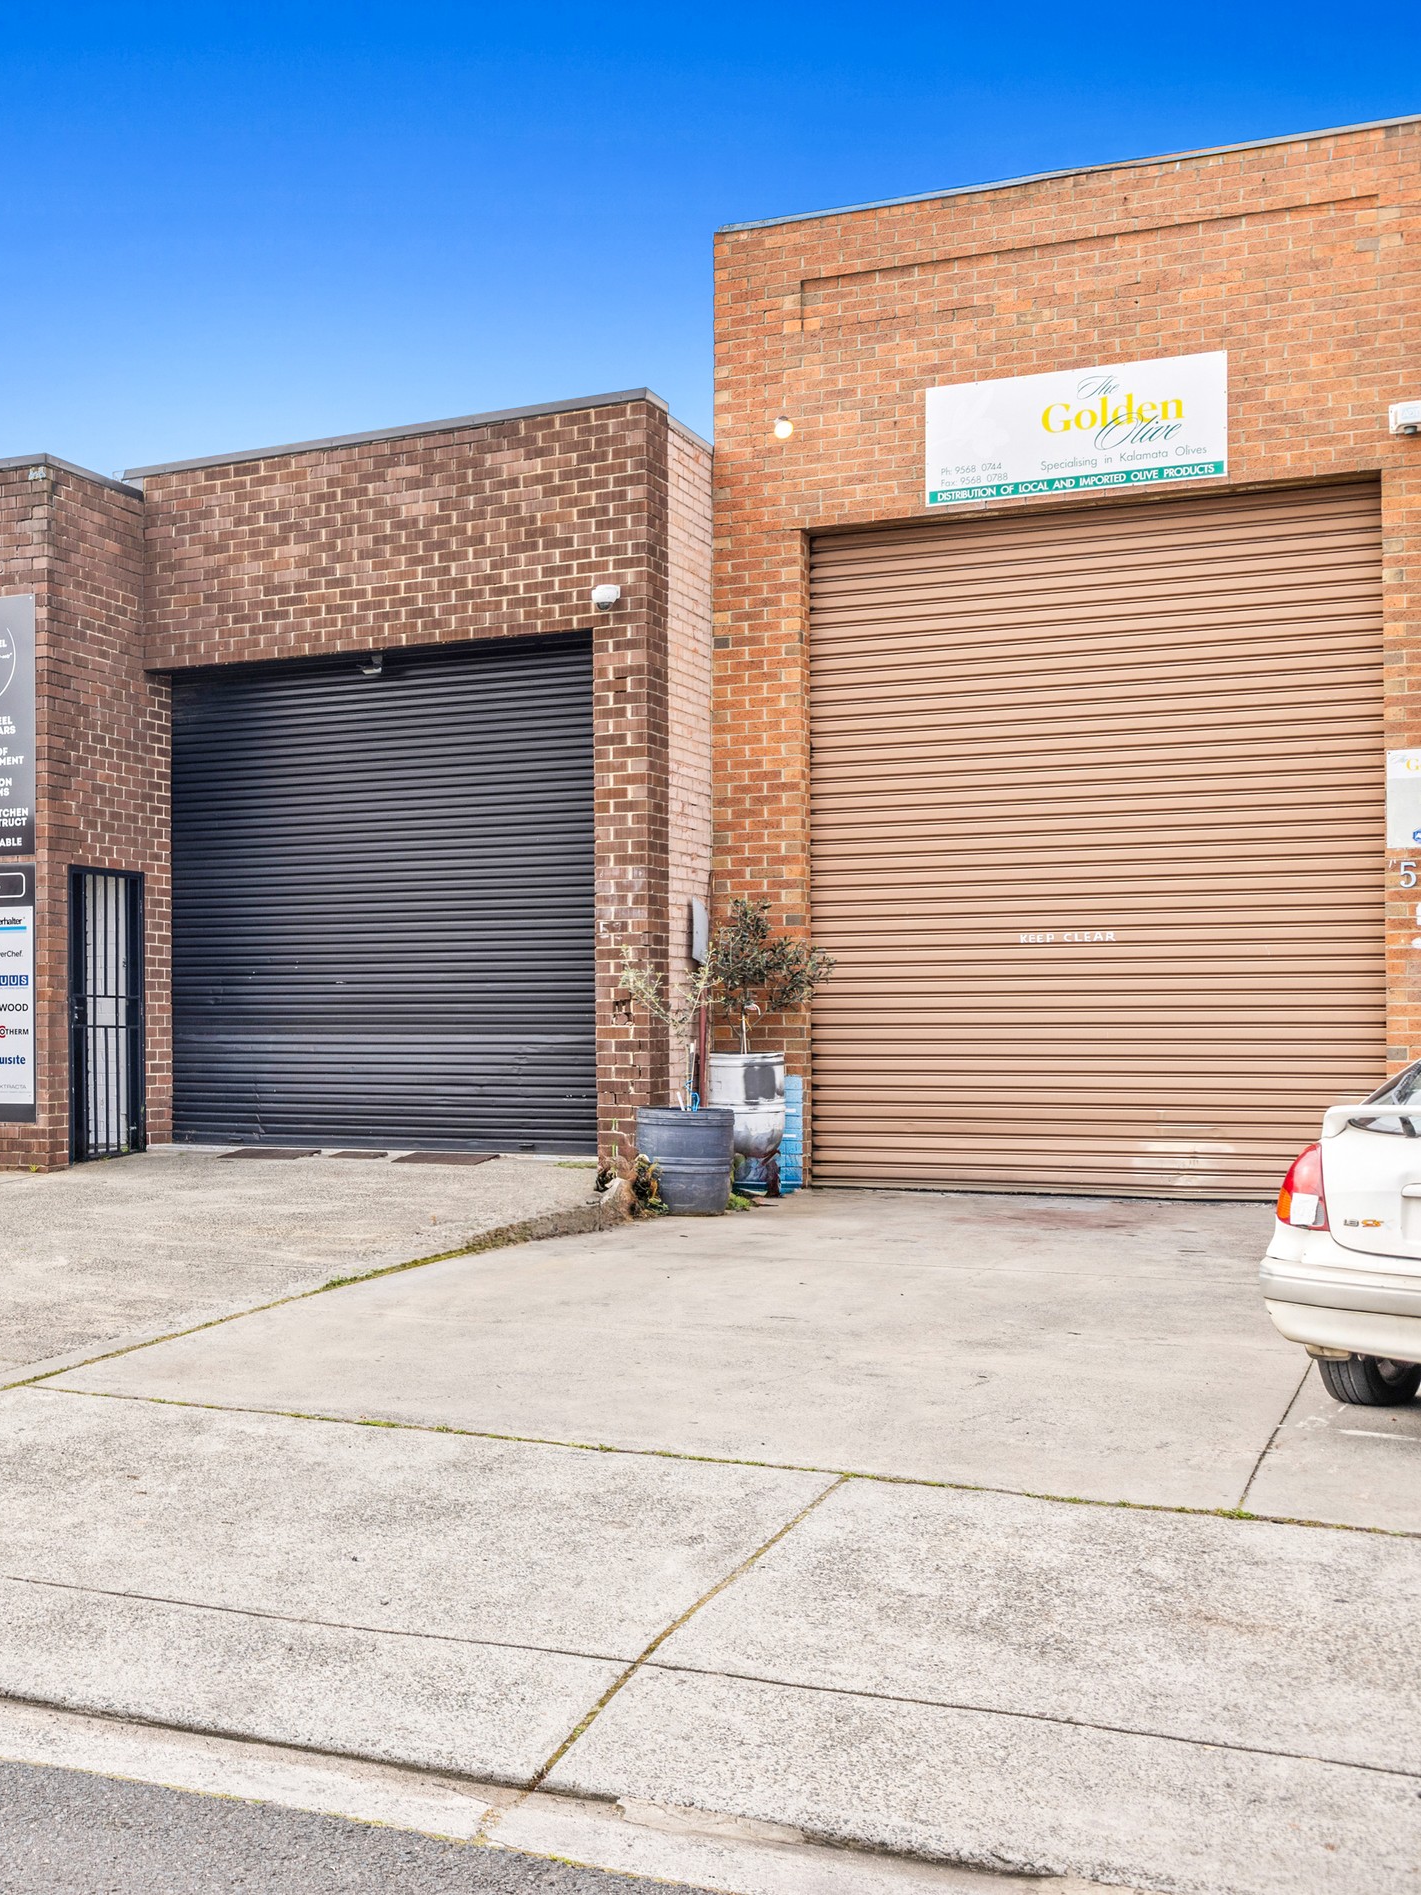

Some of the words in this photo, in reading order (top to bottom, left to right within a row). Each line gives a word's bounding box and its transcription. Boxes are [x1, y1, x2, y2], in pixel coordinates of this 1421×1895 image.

[1077, 375, 1120, 400] The
[1041, 392, 1185, 434] Golden
[1094, 411, 1182, 451] Olive
[940, 467, 953, 476] Ph:
[954, 465, 976, 475] 9568
[981, 462, 1002, 472] 0744
[1040, 457, 1098, 473] Specialising
[1104, 455, 1113, 464] in
[1119, 450, 1169, 462] Kalamata
[1175, 445, 1207, 457] Olives
[937, 487, 997, 502] DISTRIBUTION
[1000, 484, 1015, 495] OF
[1018, 480, 1049, 493] LOCAL
[1052, 478, 1076, 490] AND
[1079, 473, 1127, 487] IMPORTED
[1130, 469, 1159, 482] OLIVE
[1163, 463, 1215, 478] PRODUCTS
[940, 478, 958, 487] Fax:
[960, 475, 982, 486] 9568
[986, 472, 1008, 483] 0788
[1020, 932, 1055, 944] KEEP
[1063, 931, 1117, 943] CLEAR
